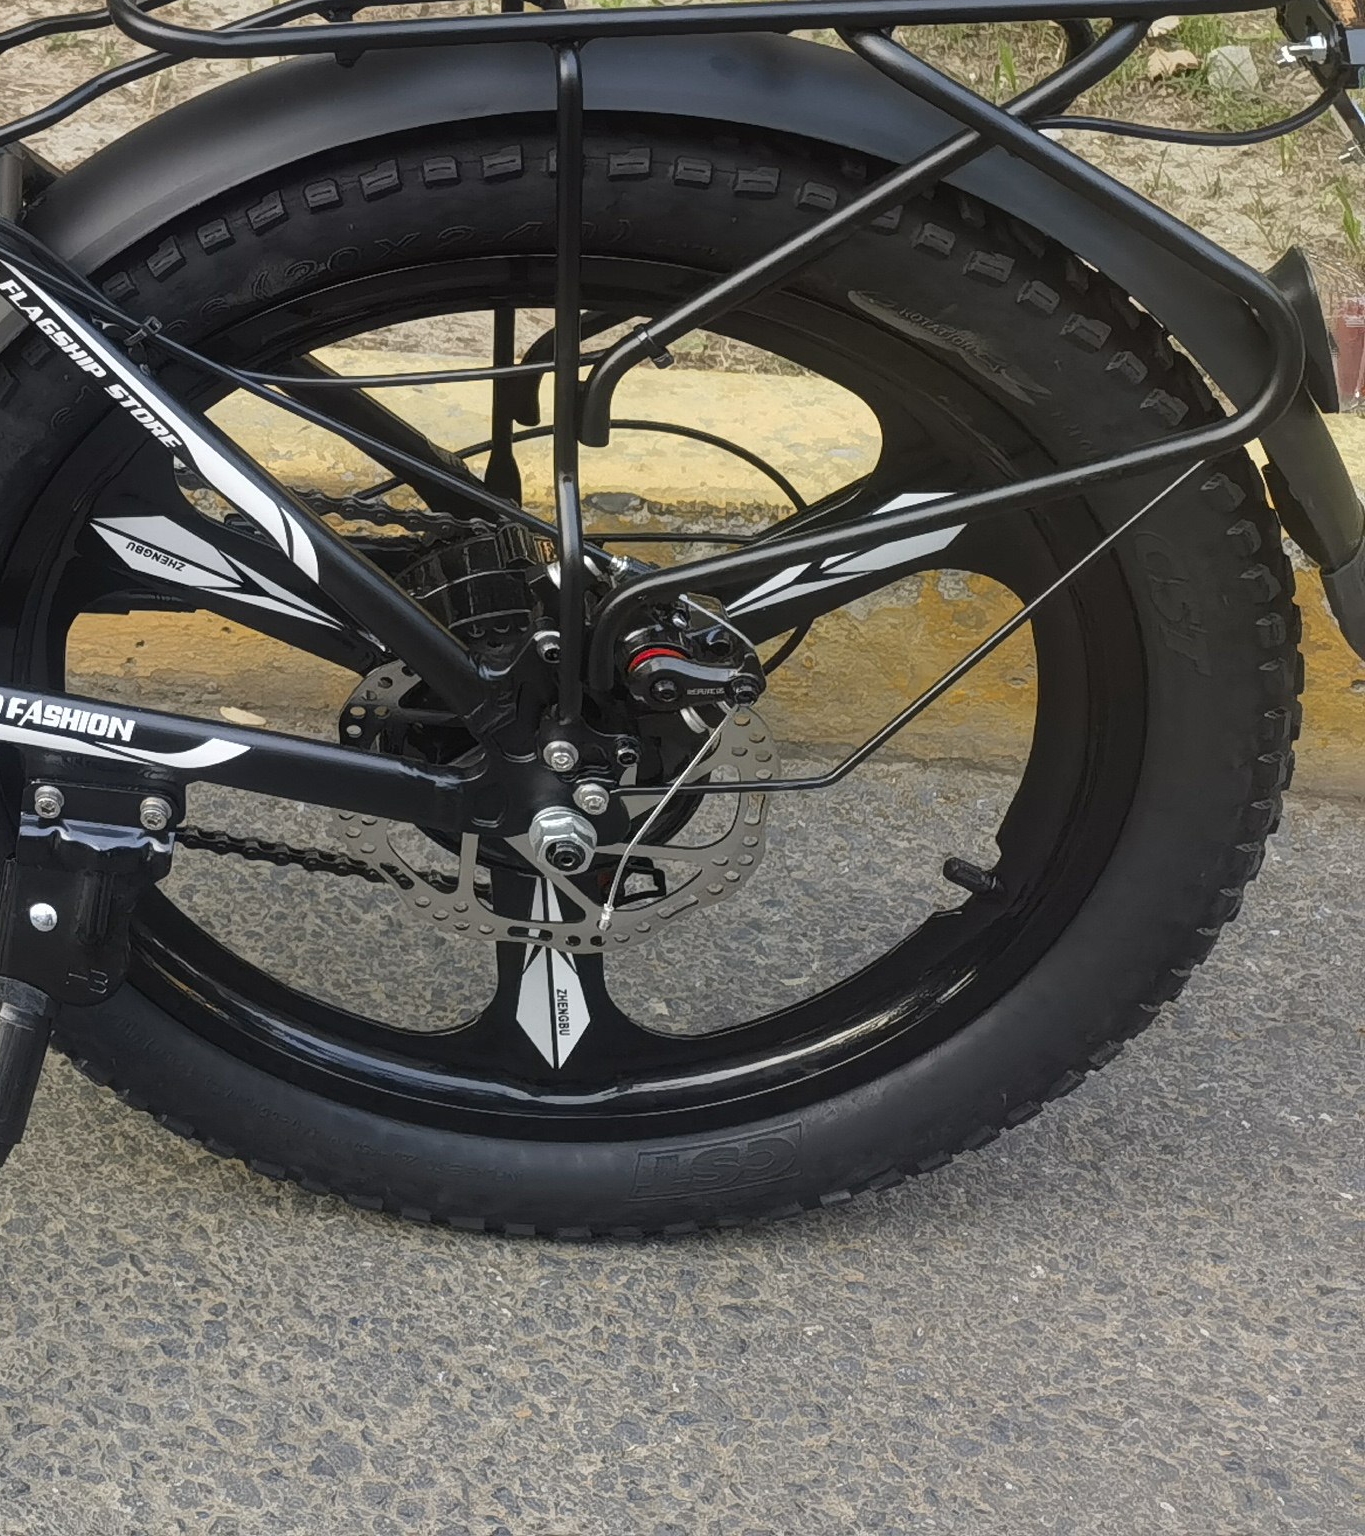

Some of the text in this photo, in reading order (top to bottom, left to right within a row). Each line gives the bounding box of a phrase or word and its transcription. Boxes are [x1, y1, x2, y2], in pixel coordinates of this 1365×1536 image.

[104, 383, 182, 448] STORE
[125, 541, 187, 572] ZHENGBU
[6, 697, 136, 742] FASHION
[556, 988, 571, 1036] ZHENGBU
